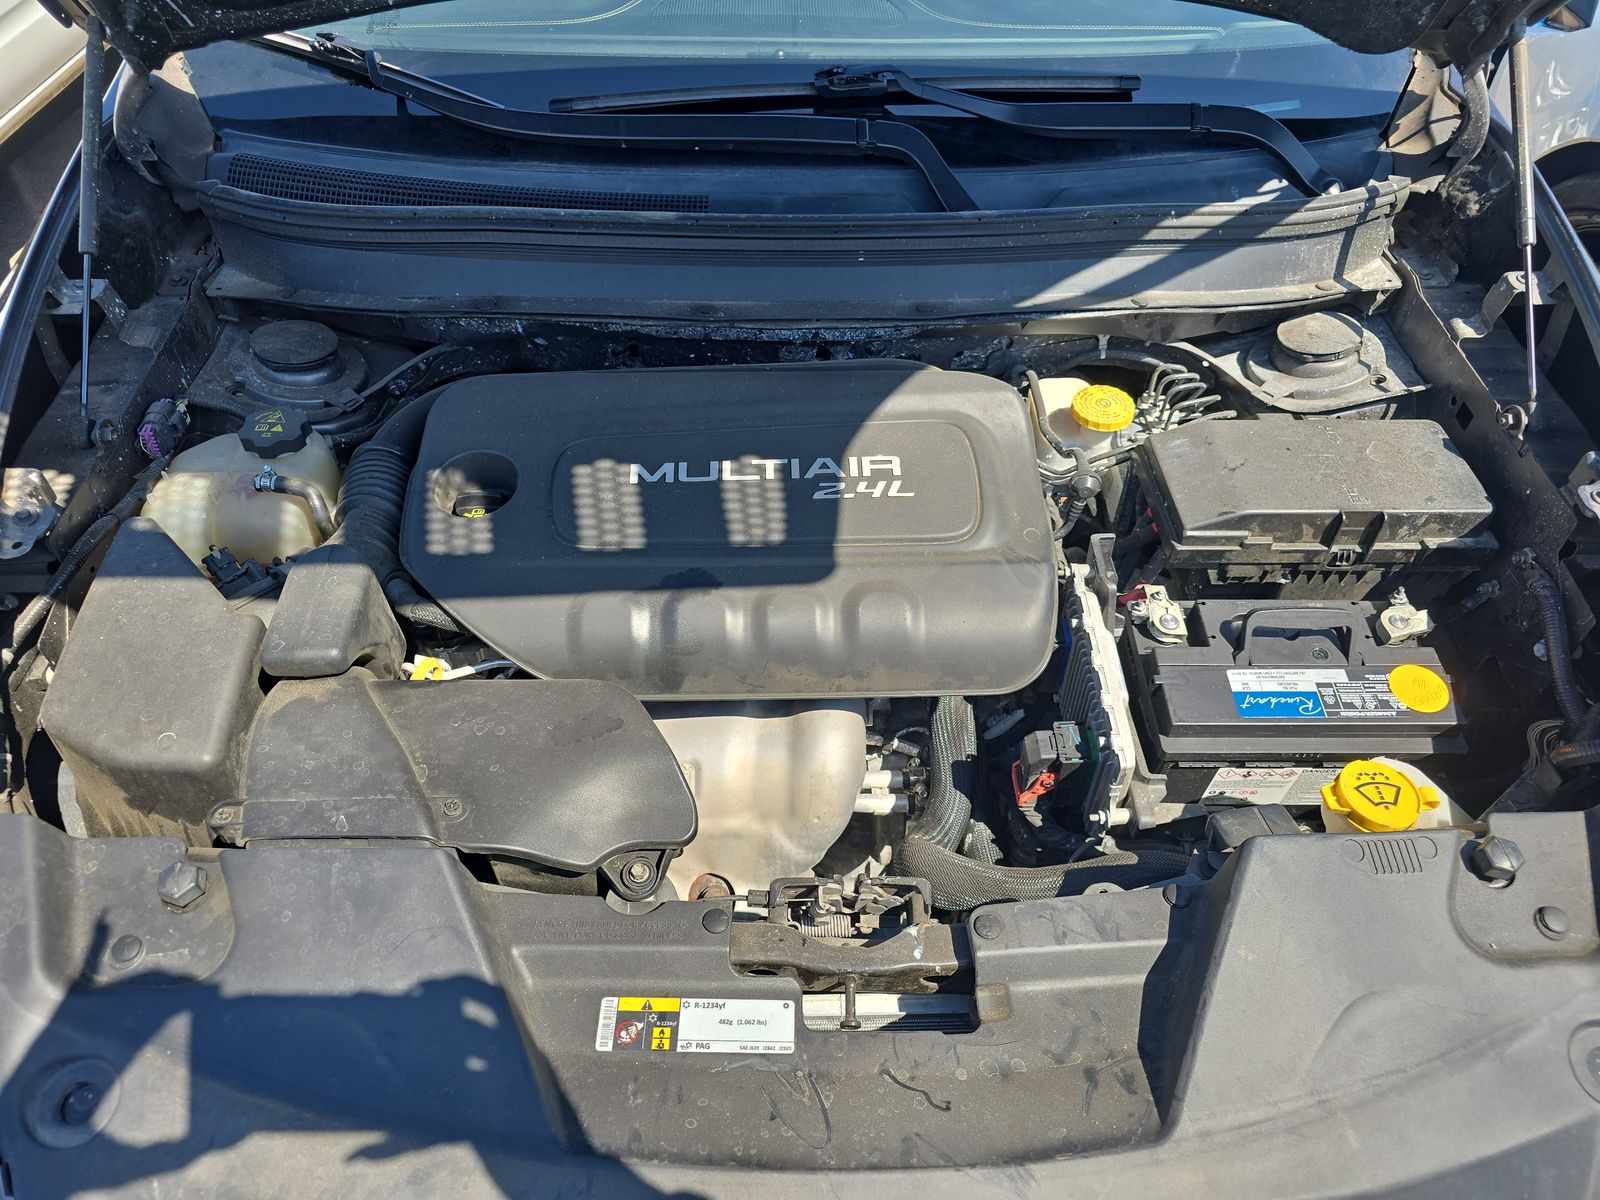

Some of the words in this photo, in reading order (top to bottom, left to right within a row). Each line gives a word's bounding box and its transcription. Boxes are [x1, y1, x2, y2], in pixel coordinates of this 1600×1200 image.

[629, 455, 903, 485] MULTIAIR
[812, 480, 916, 500] 2.4L
[1240, 693, 1322, 716] Rinehart
[694, 1001, 727, 1011] R-1234yf
[718, 1018, 734, 1027] 482g
[736, 1018, 756, 1027] (1.062
[756, 1018, 768, 1027] lbs)
[695, 1042, 711, 1051] PAG
